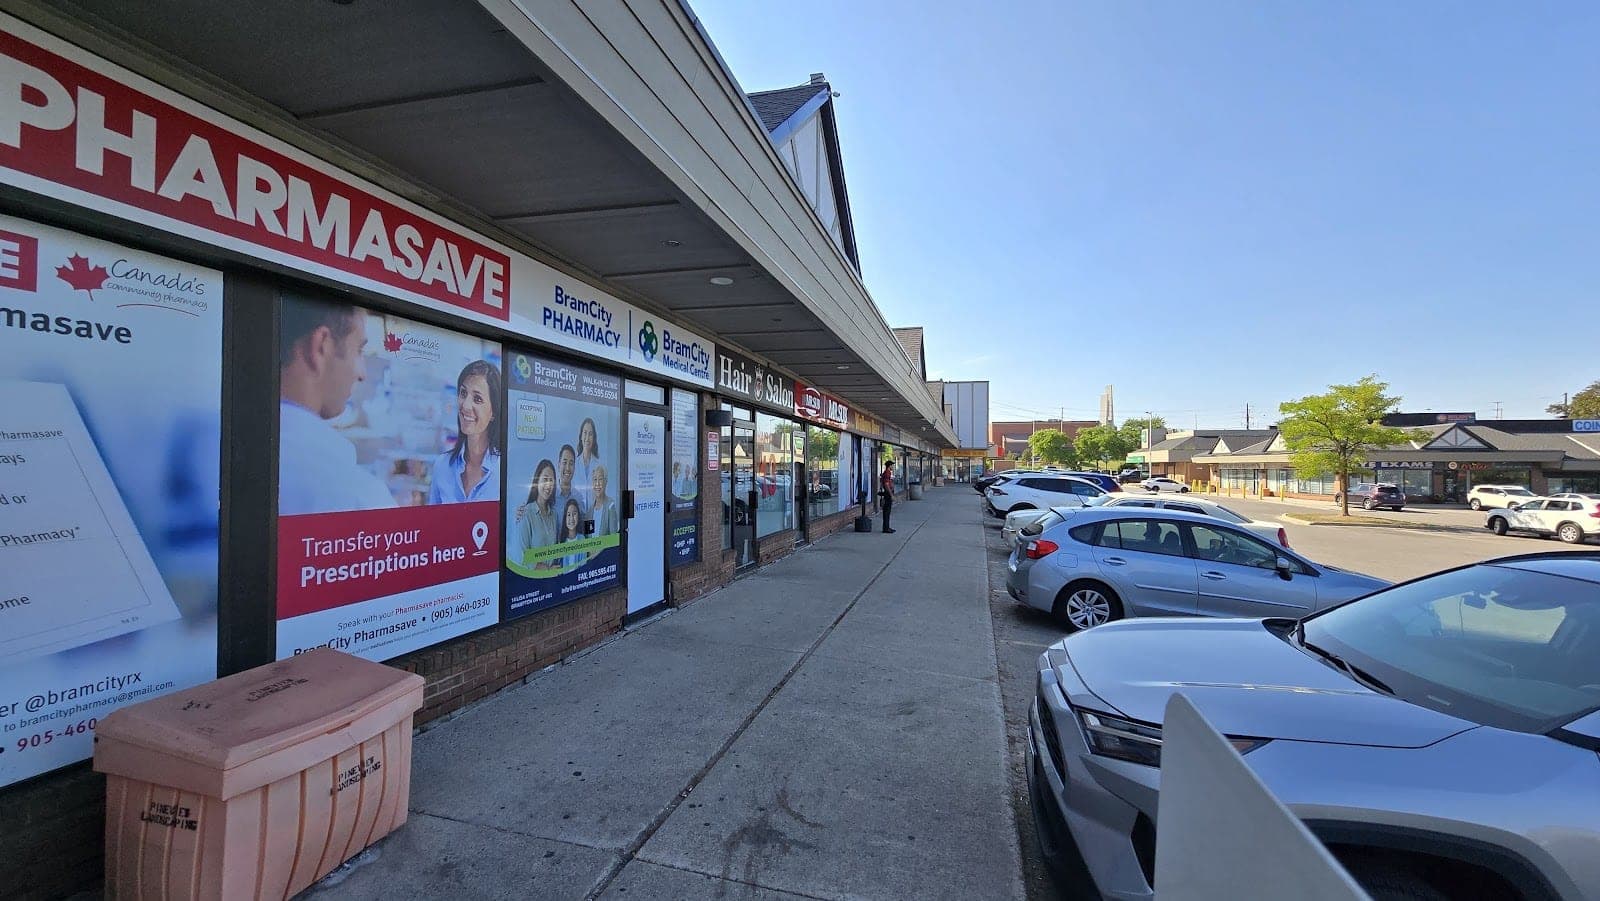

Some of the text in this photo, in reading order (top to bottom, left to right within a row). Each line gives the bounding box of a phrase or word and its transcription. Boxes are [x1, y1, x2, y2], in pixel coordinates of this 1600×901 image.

[0, 55, 504, 309] PHARMASAVE
[112, 259, 205, 295] Canada's
[107, 282, 208, 311] community pharmacy
[555, 285, 612, 327] BramCity
[0, 307, 132, 345] masave
[403, 333, 439, 349] Canada's
[543, 307, 621, 348] PHARMACY
[663, 330, 710, 370] BramCity
[663, 354, 710, 381] Medical Centre
[534, 361, 578, 385] BramCity
[534, 376, 577, 392] Medical Centre
[719, 354, 794, 409] Hair Salon
[0, 430, 64, 440] harmasave
[1381, 461, 1434, 469] EXAMS
[12, 495, 27, 504] or
[302, 528, 421, 558] Transfer your
[301, 545, 465, 588] Prescriptions here
[337, 593, 465, 631] Speak with your Pharmasave pharmacist
[354, 618, 417, 643] Pharmasave
[431, 609, 453, 624] (905)
[455, 597, 491, 614] 460-0330
[26, 671, 142, 713] @bramcityrx
[4, 723, 16, 733] to
